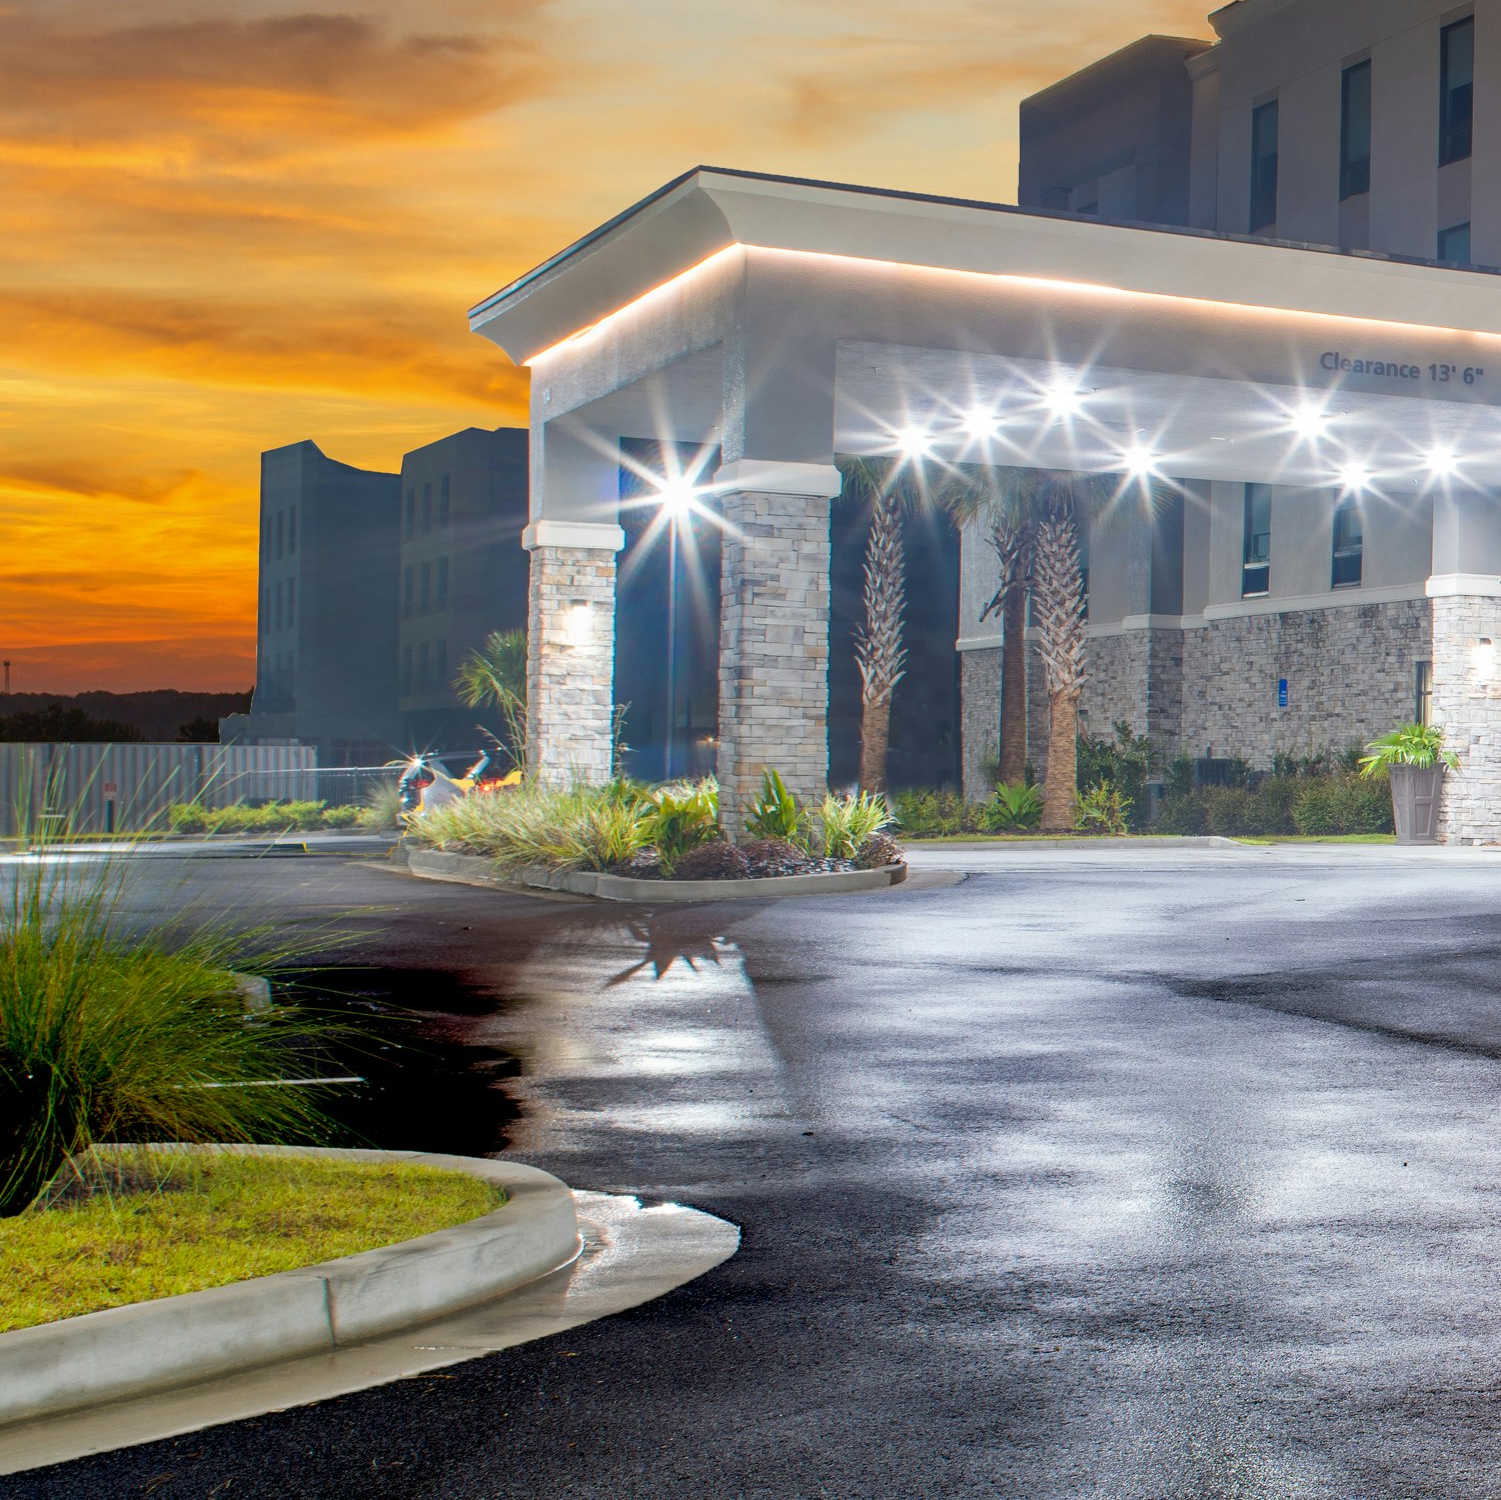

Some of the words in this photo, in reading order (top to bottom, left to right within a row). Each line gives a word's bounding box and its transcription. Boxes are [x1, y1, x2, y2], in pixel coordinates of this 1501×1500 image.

[1319, 351, 1421, 380] Clearance
[1428, 363, 1457, 382] 13'
[1463, 366, 1484, 385] 6"
